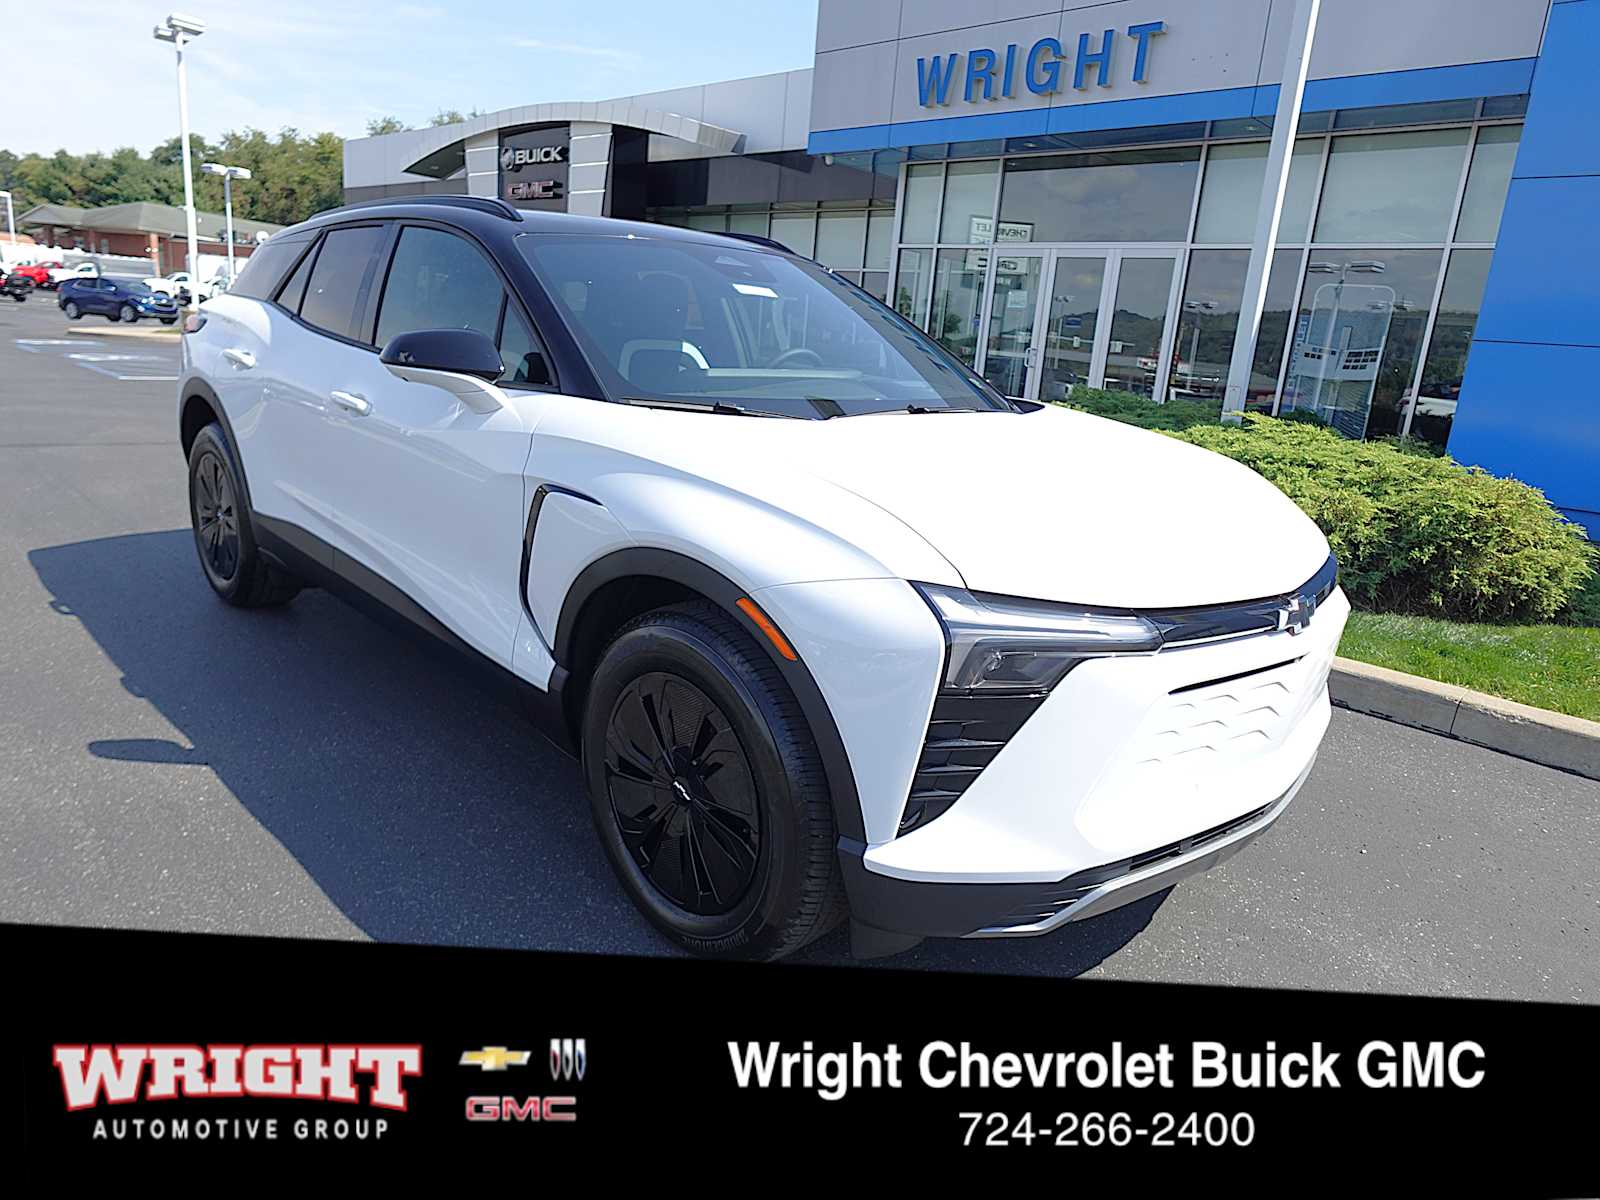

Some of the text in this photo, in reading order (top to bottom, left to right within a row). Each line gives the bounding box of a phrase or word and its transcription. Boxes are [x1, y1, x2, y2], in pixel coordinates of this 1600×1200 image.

[916, 20, 1168, 108] WRIGHT
[514, 146, 563, 165] BUICK
[508, 180, 554, 200] GMC
